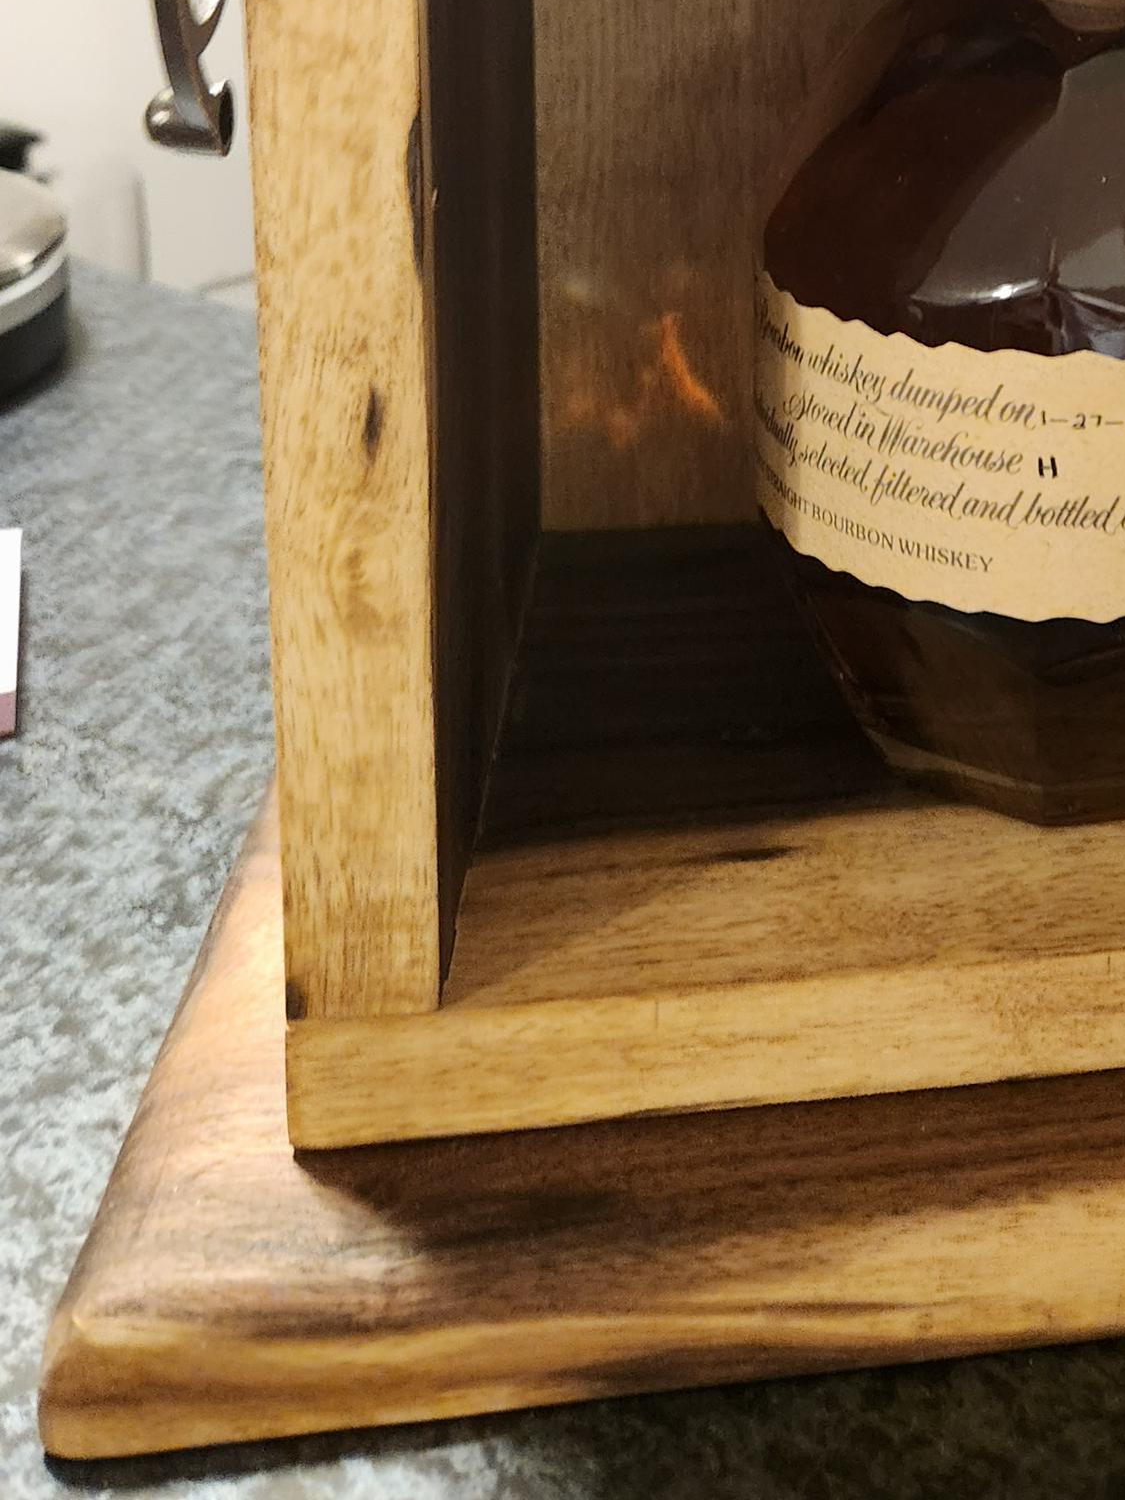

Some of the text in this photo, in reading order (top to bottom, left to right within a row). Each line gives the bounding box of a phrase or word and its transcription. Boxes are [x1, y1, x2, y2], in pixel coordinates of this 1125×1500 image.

[782, 382, 858, 440] Stored
[854, 411, 876, 447] in
[873, 405, 1023, 474] Warehouse
[1037, 456, 1058, 479] H
[808, 344, 887, 403] whiskey
[890, 368, 1003, 422] dumped
[1000, 404, 1036, 430] on
[761, 462, 809, 514] TRAIGHT
[812, 503, 894, 550] BOURBON
[898, 538, 994, 572] WHISKEY
[870, 464, 965, 518] filtered
[962, 491, 1024, 529] and
